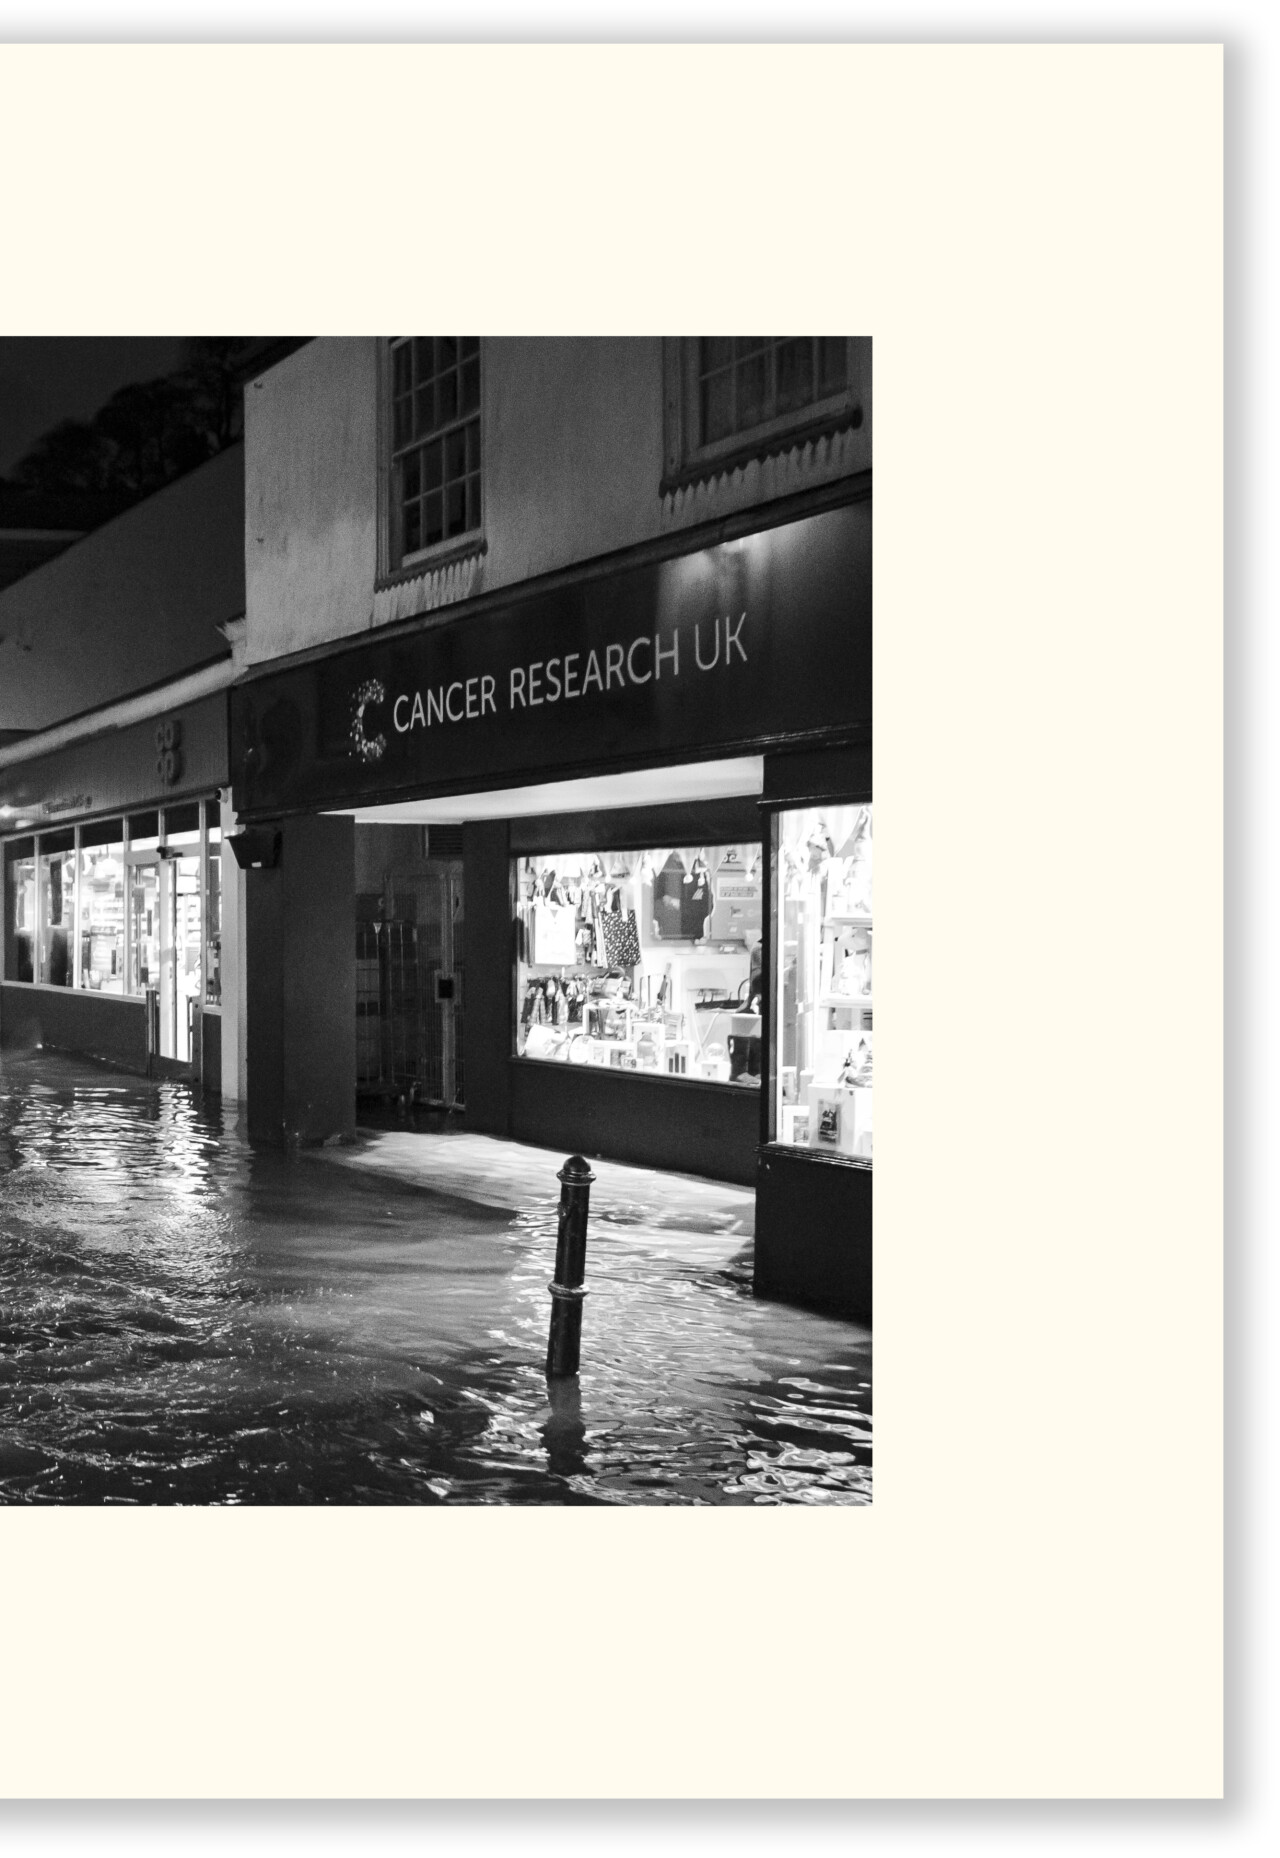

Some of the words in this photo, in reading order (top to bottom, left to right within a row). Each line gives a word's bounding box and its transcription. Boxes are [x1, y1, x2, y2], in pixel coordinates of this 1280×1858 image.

[392, 675, 497, 732] CANCER
[509, 628, 680, 710] RESEARCH
[694, 611, 748, 671] UK
